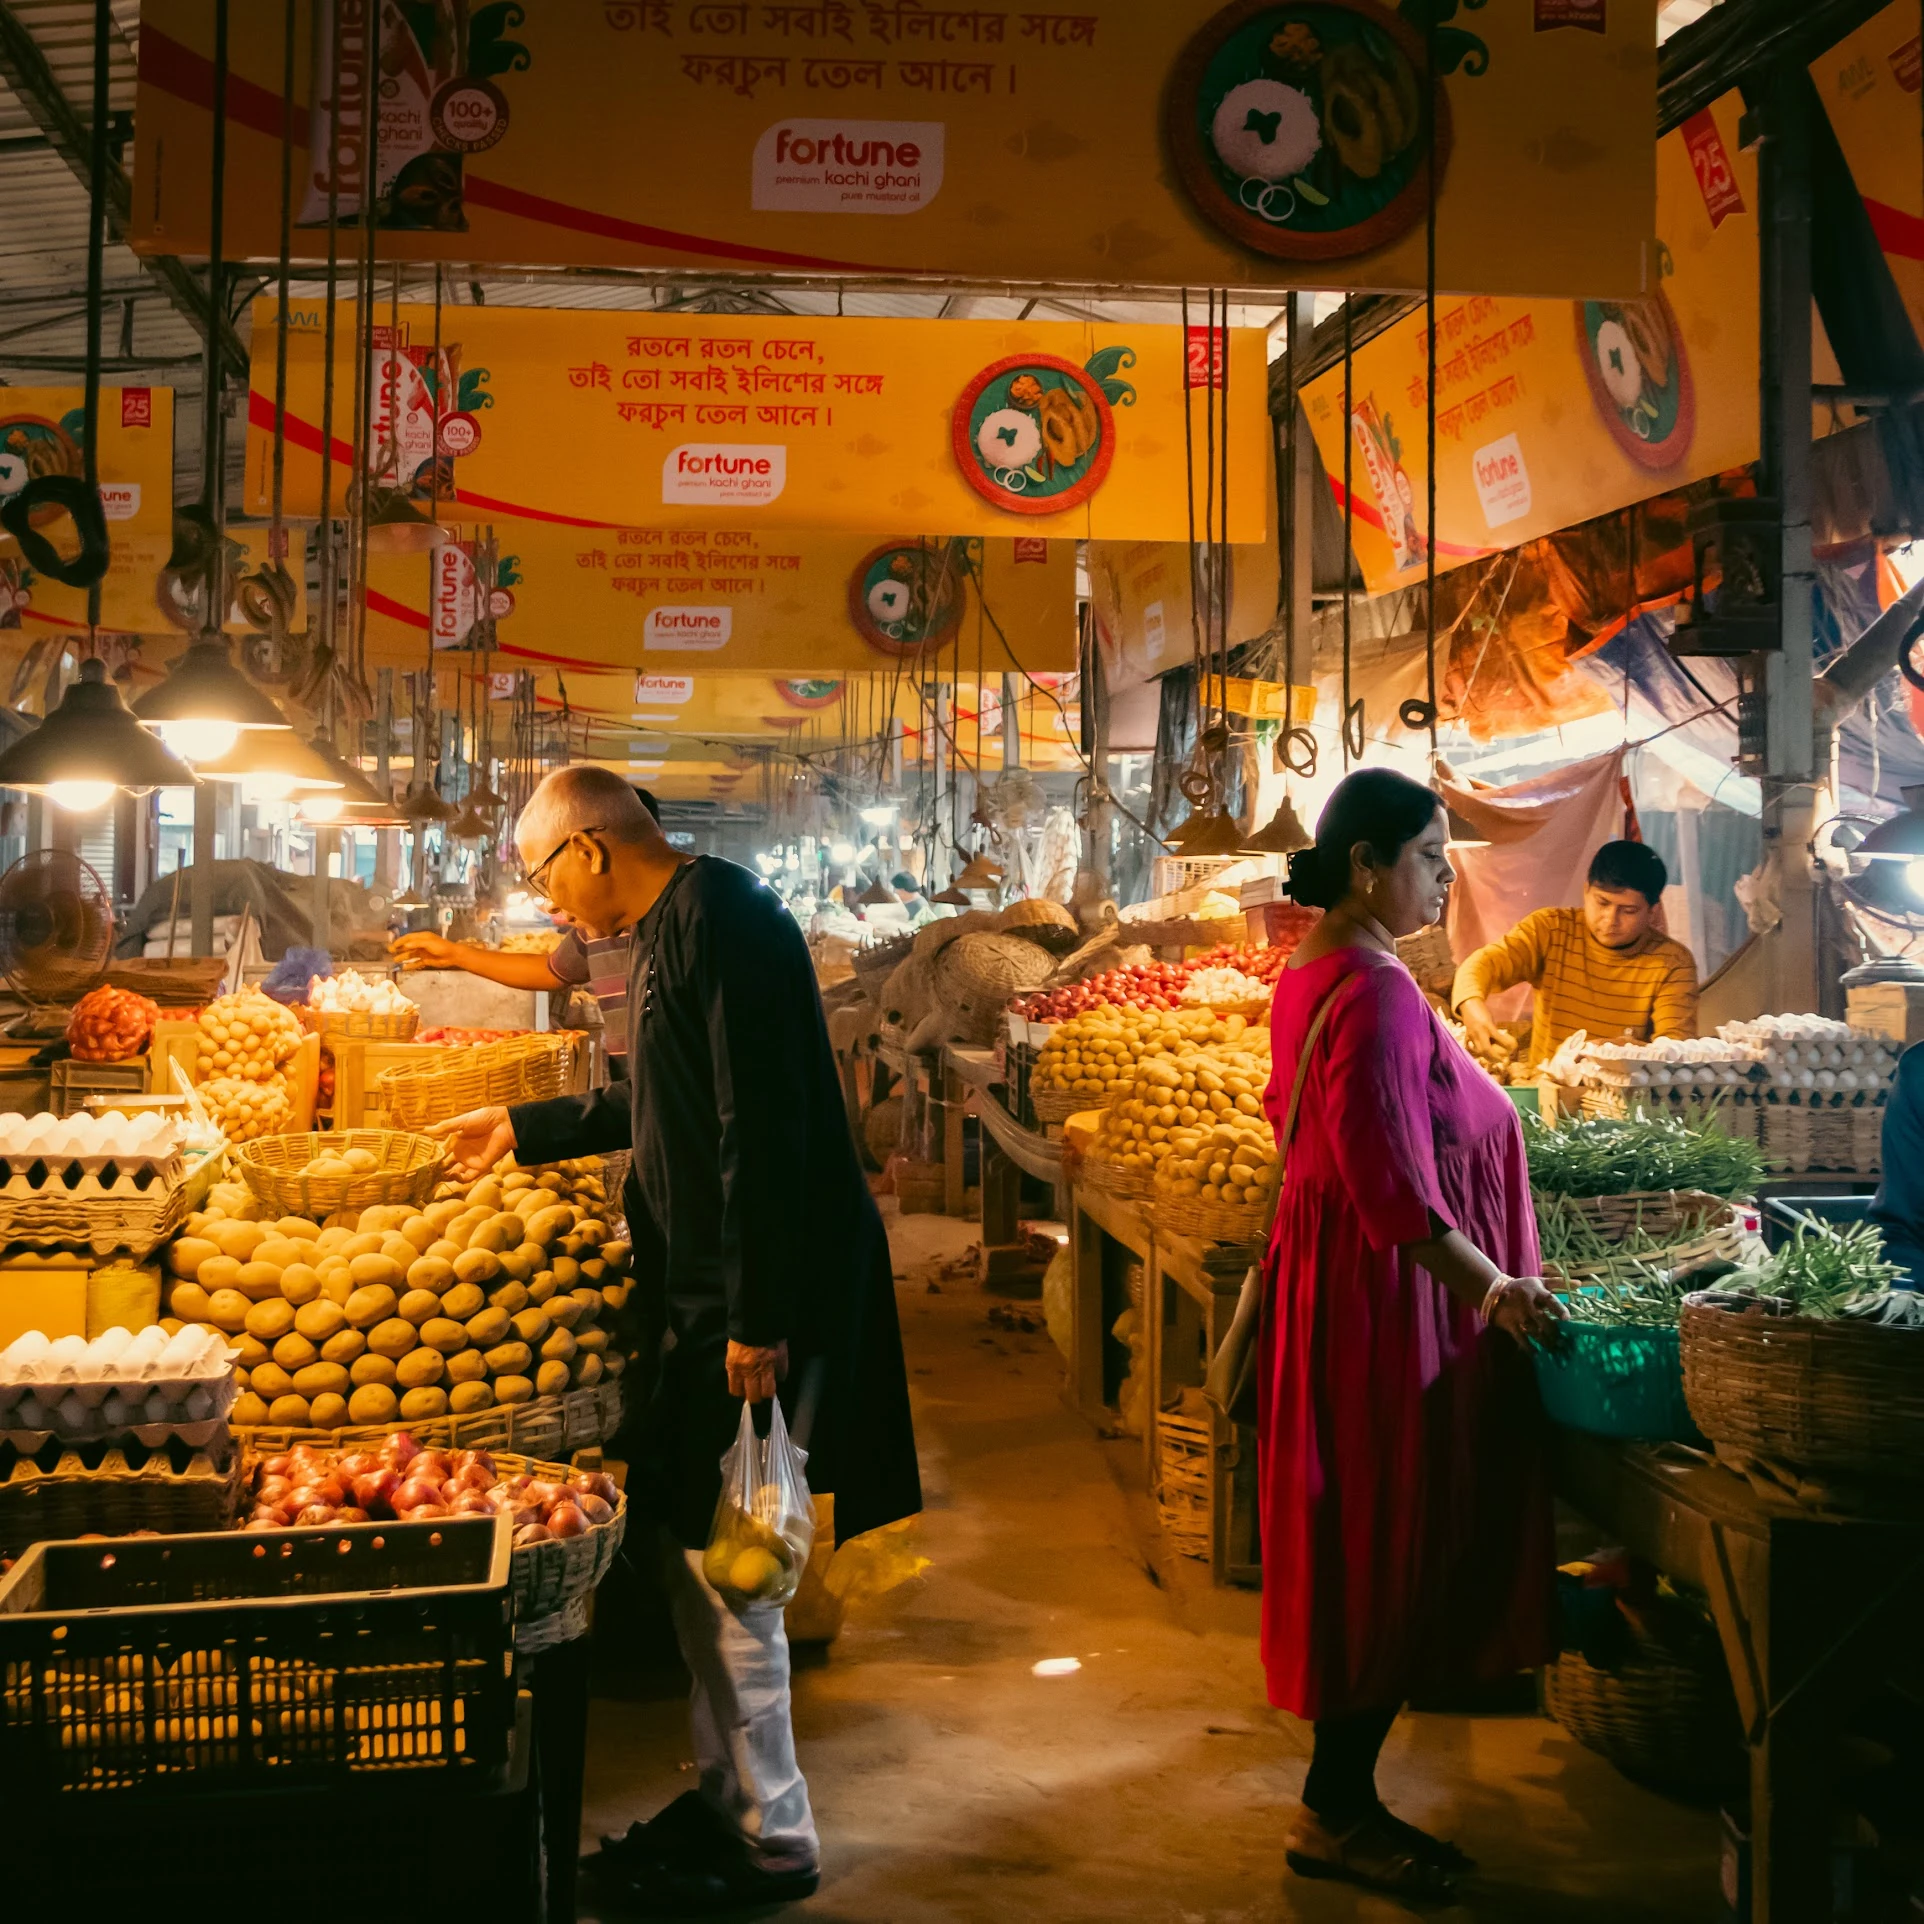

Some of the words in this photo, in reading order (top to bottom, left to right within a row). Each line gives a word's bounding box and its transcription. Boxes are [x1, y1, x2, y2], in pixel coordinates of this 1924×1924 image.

[603, 0, 673, 37] তাই
[689, 2, 751, 35] তো
[762, 0, 854, 45] সবাই
[862, 0, 1008, 45] ইলিশের
[1020, 13, 1098, 46] সঙ্গে
[680, 55, 790, 99] ফরচুন
[801, 58, 887, 90] তেল
[449, 101, 493, 118] 100+
[777, 129, 920, 167] fortune
[825, 170, 869, 185] kachi
[875, 173, 920, 189] ghani
[626, 336, 692, 357] রতনে
[699, 338, 753, 359] রতন
[762, 340, 824, 366] চেনে,
[568, 361, 612, 392] তাই
[622, 368, 662, 390] তো
[670, 364, 730, 395] সবাই
[731, 365, 826, 395] ইলিশের
[834, 374, 884, 395] সঙ্গে
[124, 398, 149, 418] 25
[617, 401, 688, 431] ফরচুন
[695, 404, 748, 424] তেল
[447, 426, 471, 436] 100+
[678, 451, 771, 474] fortune
[709, 477, 738, 487] kachi
[741, 478, 771, 489] ghani
[436, 552, 457, 637] fortune
[655, 611, 721, 628] fortune
